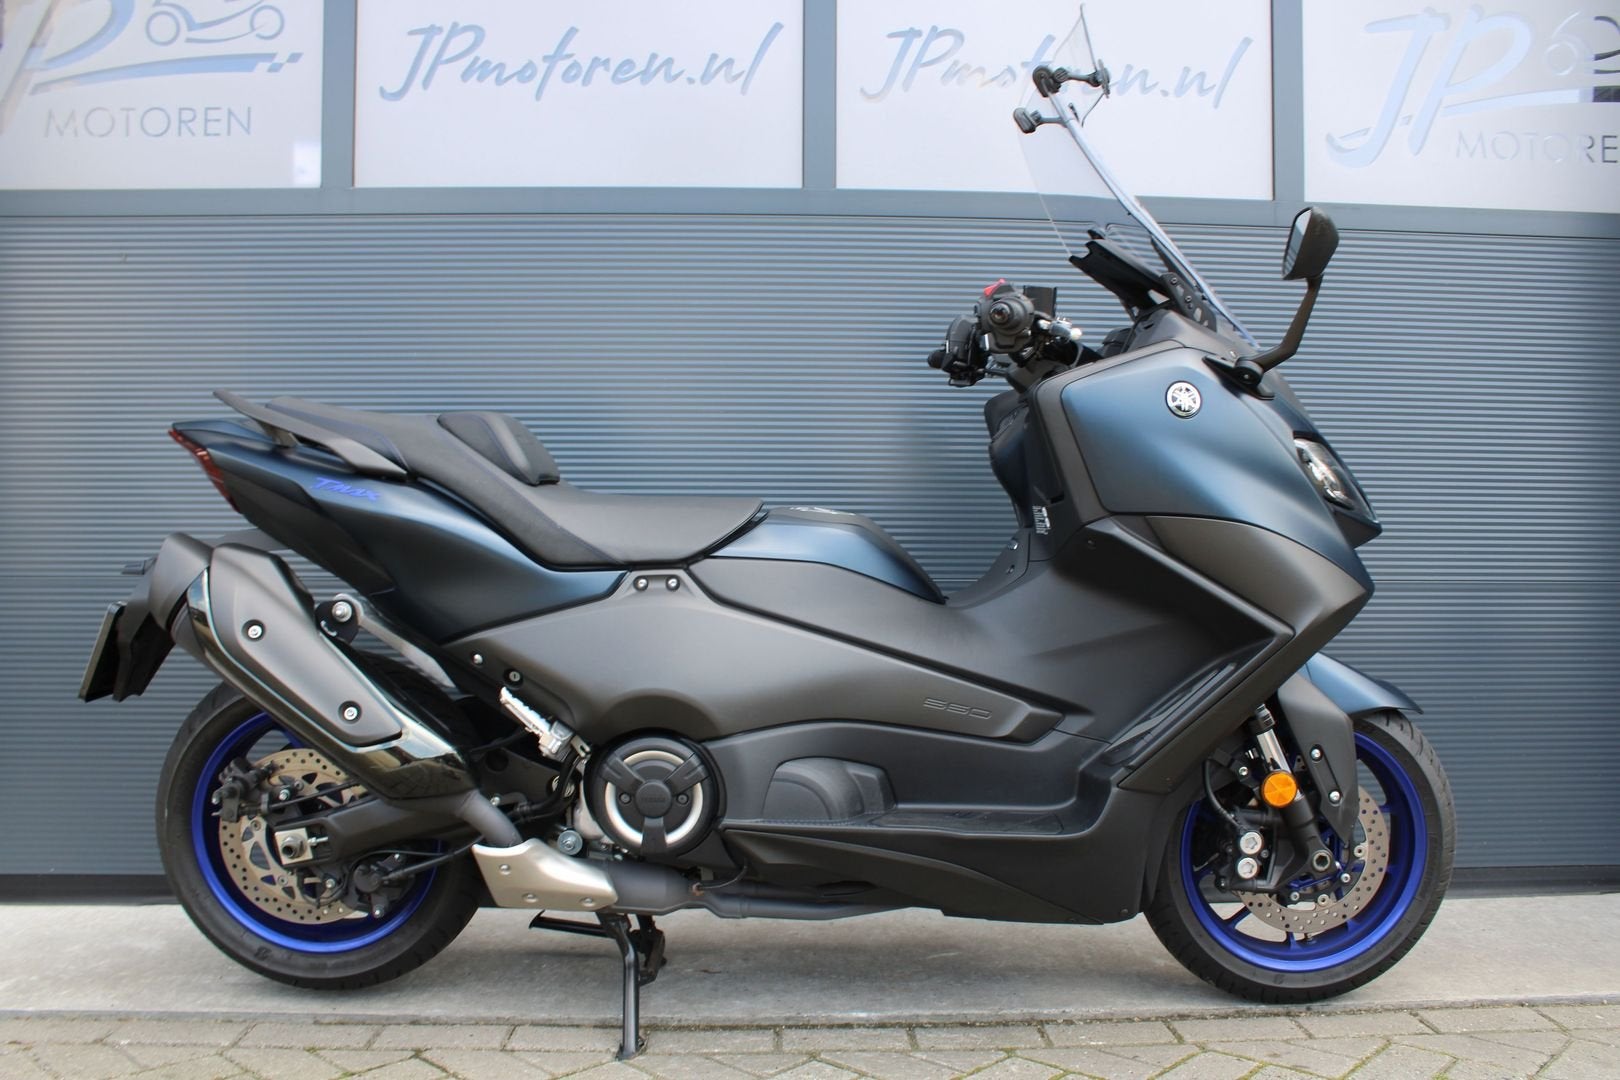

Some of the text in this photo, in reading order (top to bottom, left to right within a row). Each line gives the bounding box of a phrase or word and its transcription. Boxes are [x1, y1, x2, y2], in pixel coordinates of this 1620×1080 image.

[379, 21, 785, 101] JPmotoren.nl
[44, 106, 252, 138] MOTOREN
[1455, 130, 1620, 164] MOTORE
